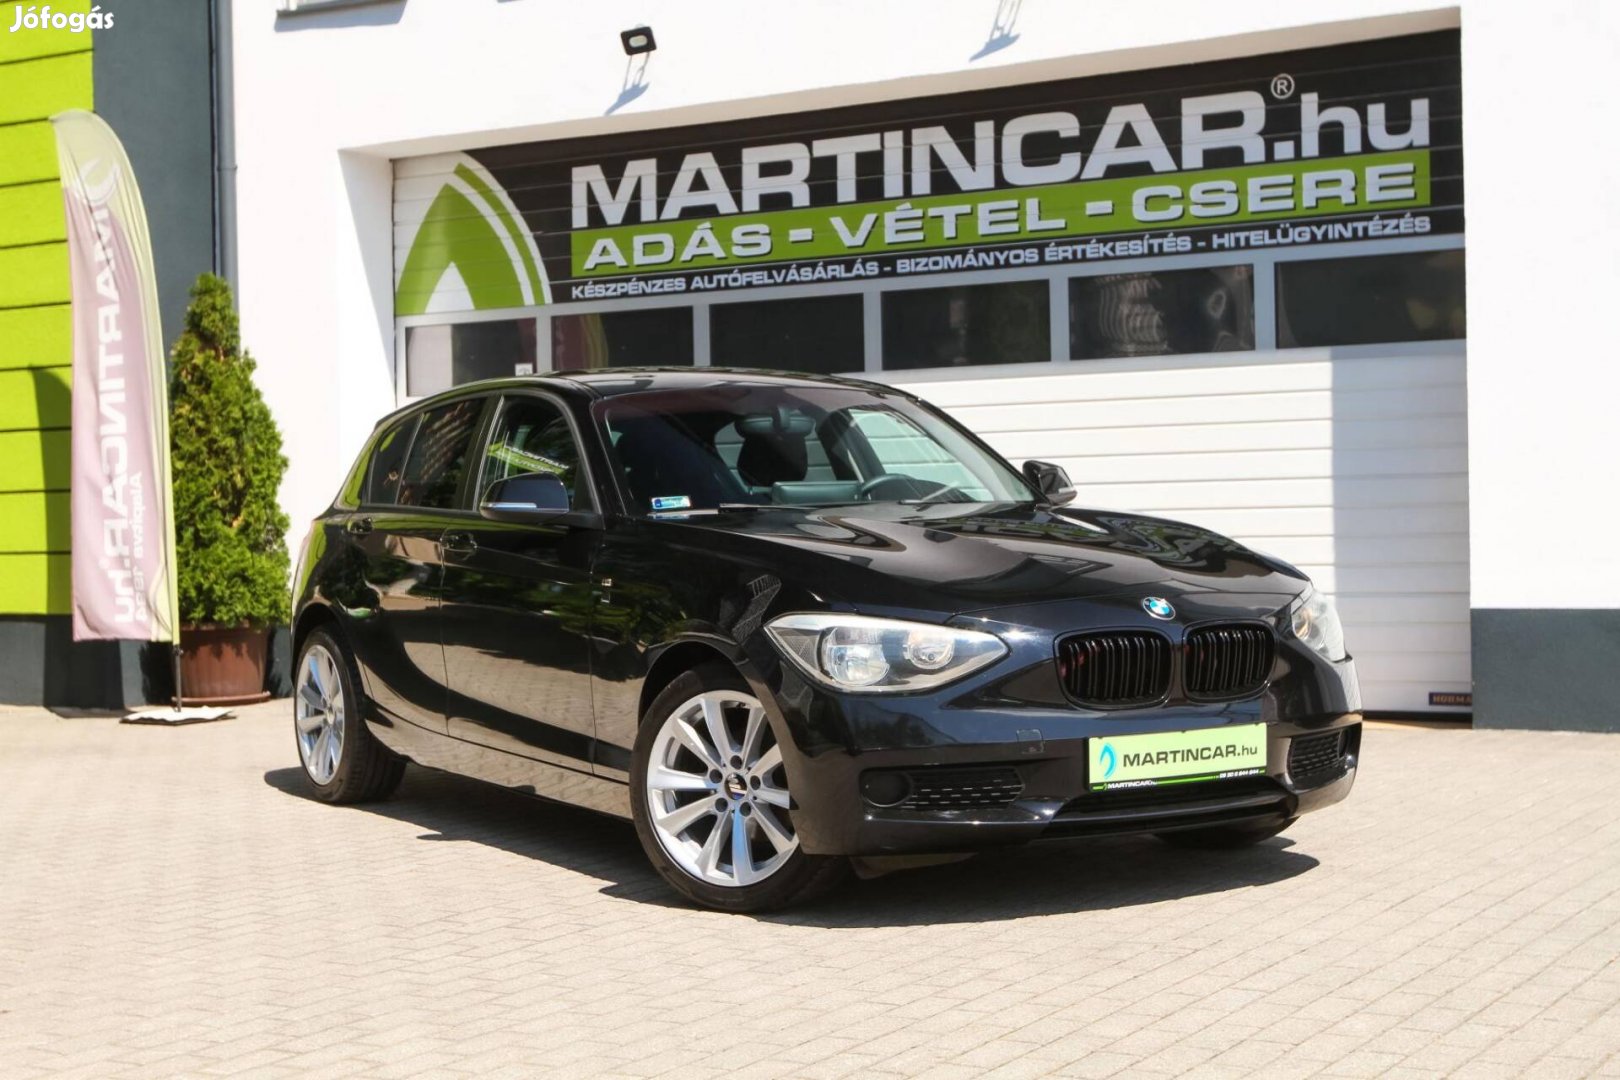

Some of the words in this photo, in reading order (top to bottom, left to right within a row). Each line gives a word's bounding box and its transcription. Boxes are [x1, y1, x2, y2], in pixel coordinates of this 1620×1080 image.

[571, 277, 687, 300] KÉSZPÉNZES
[690, 260, 880, 291] AUTÓFELVÁSÁRLÁS
[896, 246, 1040, 274] BIZOMÁNYOS
[1044, 232, 1193, 263] ÉRTÉKESÍTÉS
[1212, 212, 1431, 249] HITELÜGYINTÉZÉS
[583, 221, 772, 270] ADÁS
[831, 201, 1066, 247] VÉTEL
[1132, 162, 1417, 223] CSERE
[1123, 744, 1258, 768] MARTINCAR.hu
